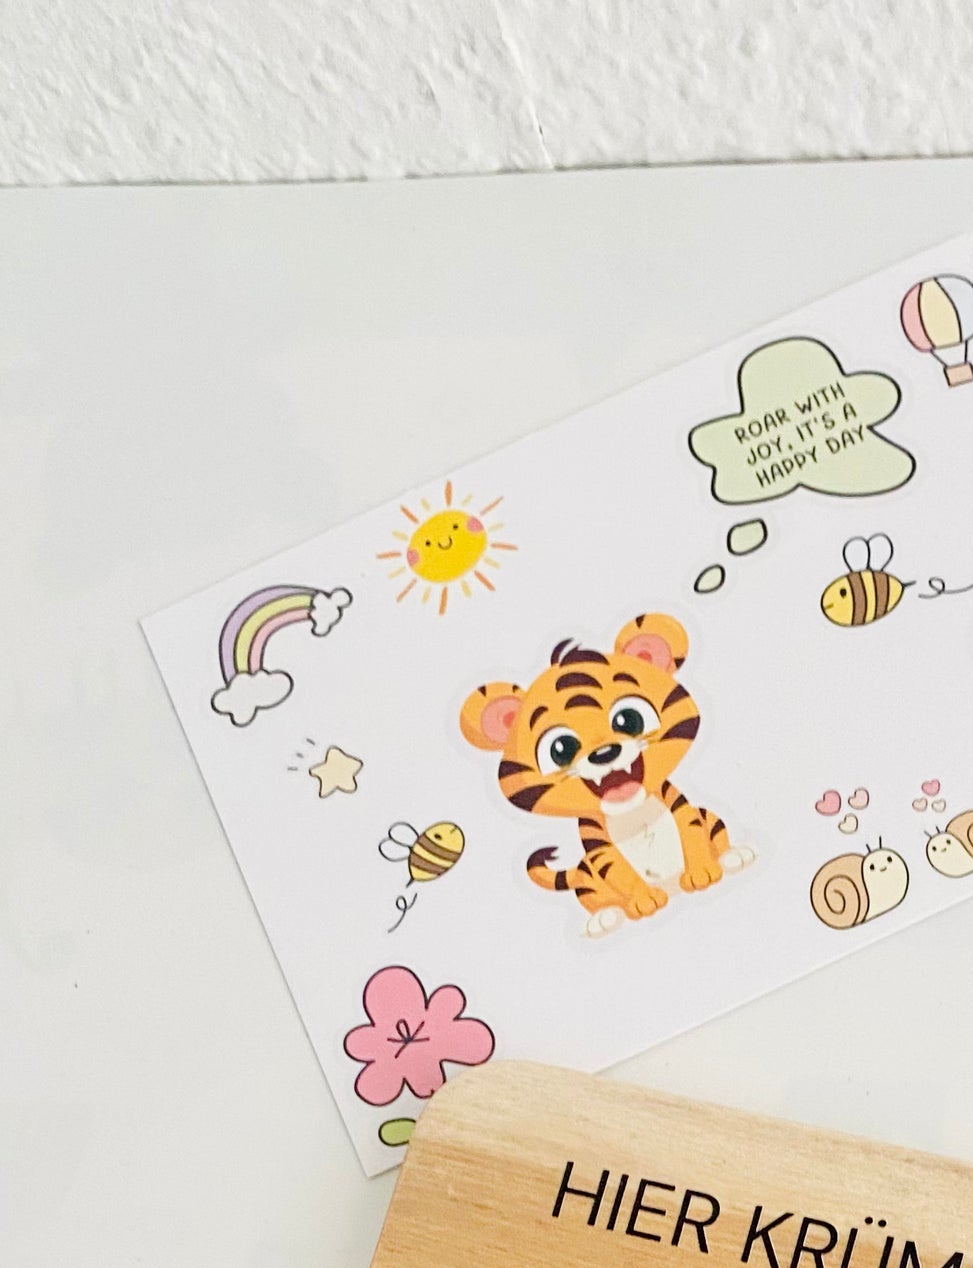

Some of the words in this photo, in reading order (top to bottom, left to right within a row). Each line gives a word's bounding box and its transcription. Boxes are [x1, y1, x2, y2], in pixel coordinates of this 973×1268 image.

[734, 408, 791, 444] ROAR
[794, 382, 846, 414] WITH
[746, 437, 793, 466] JOY,
[796, 412, 836, 441] IT'S
[842, 402, 857, 422] A
[756, 446, 818, 487] HAPPY
[825, 425, 867, 454] DAY
[552, 1161, 720, 1254] HIER
